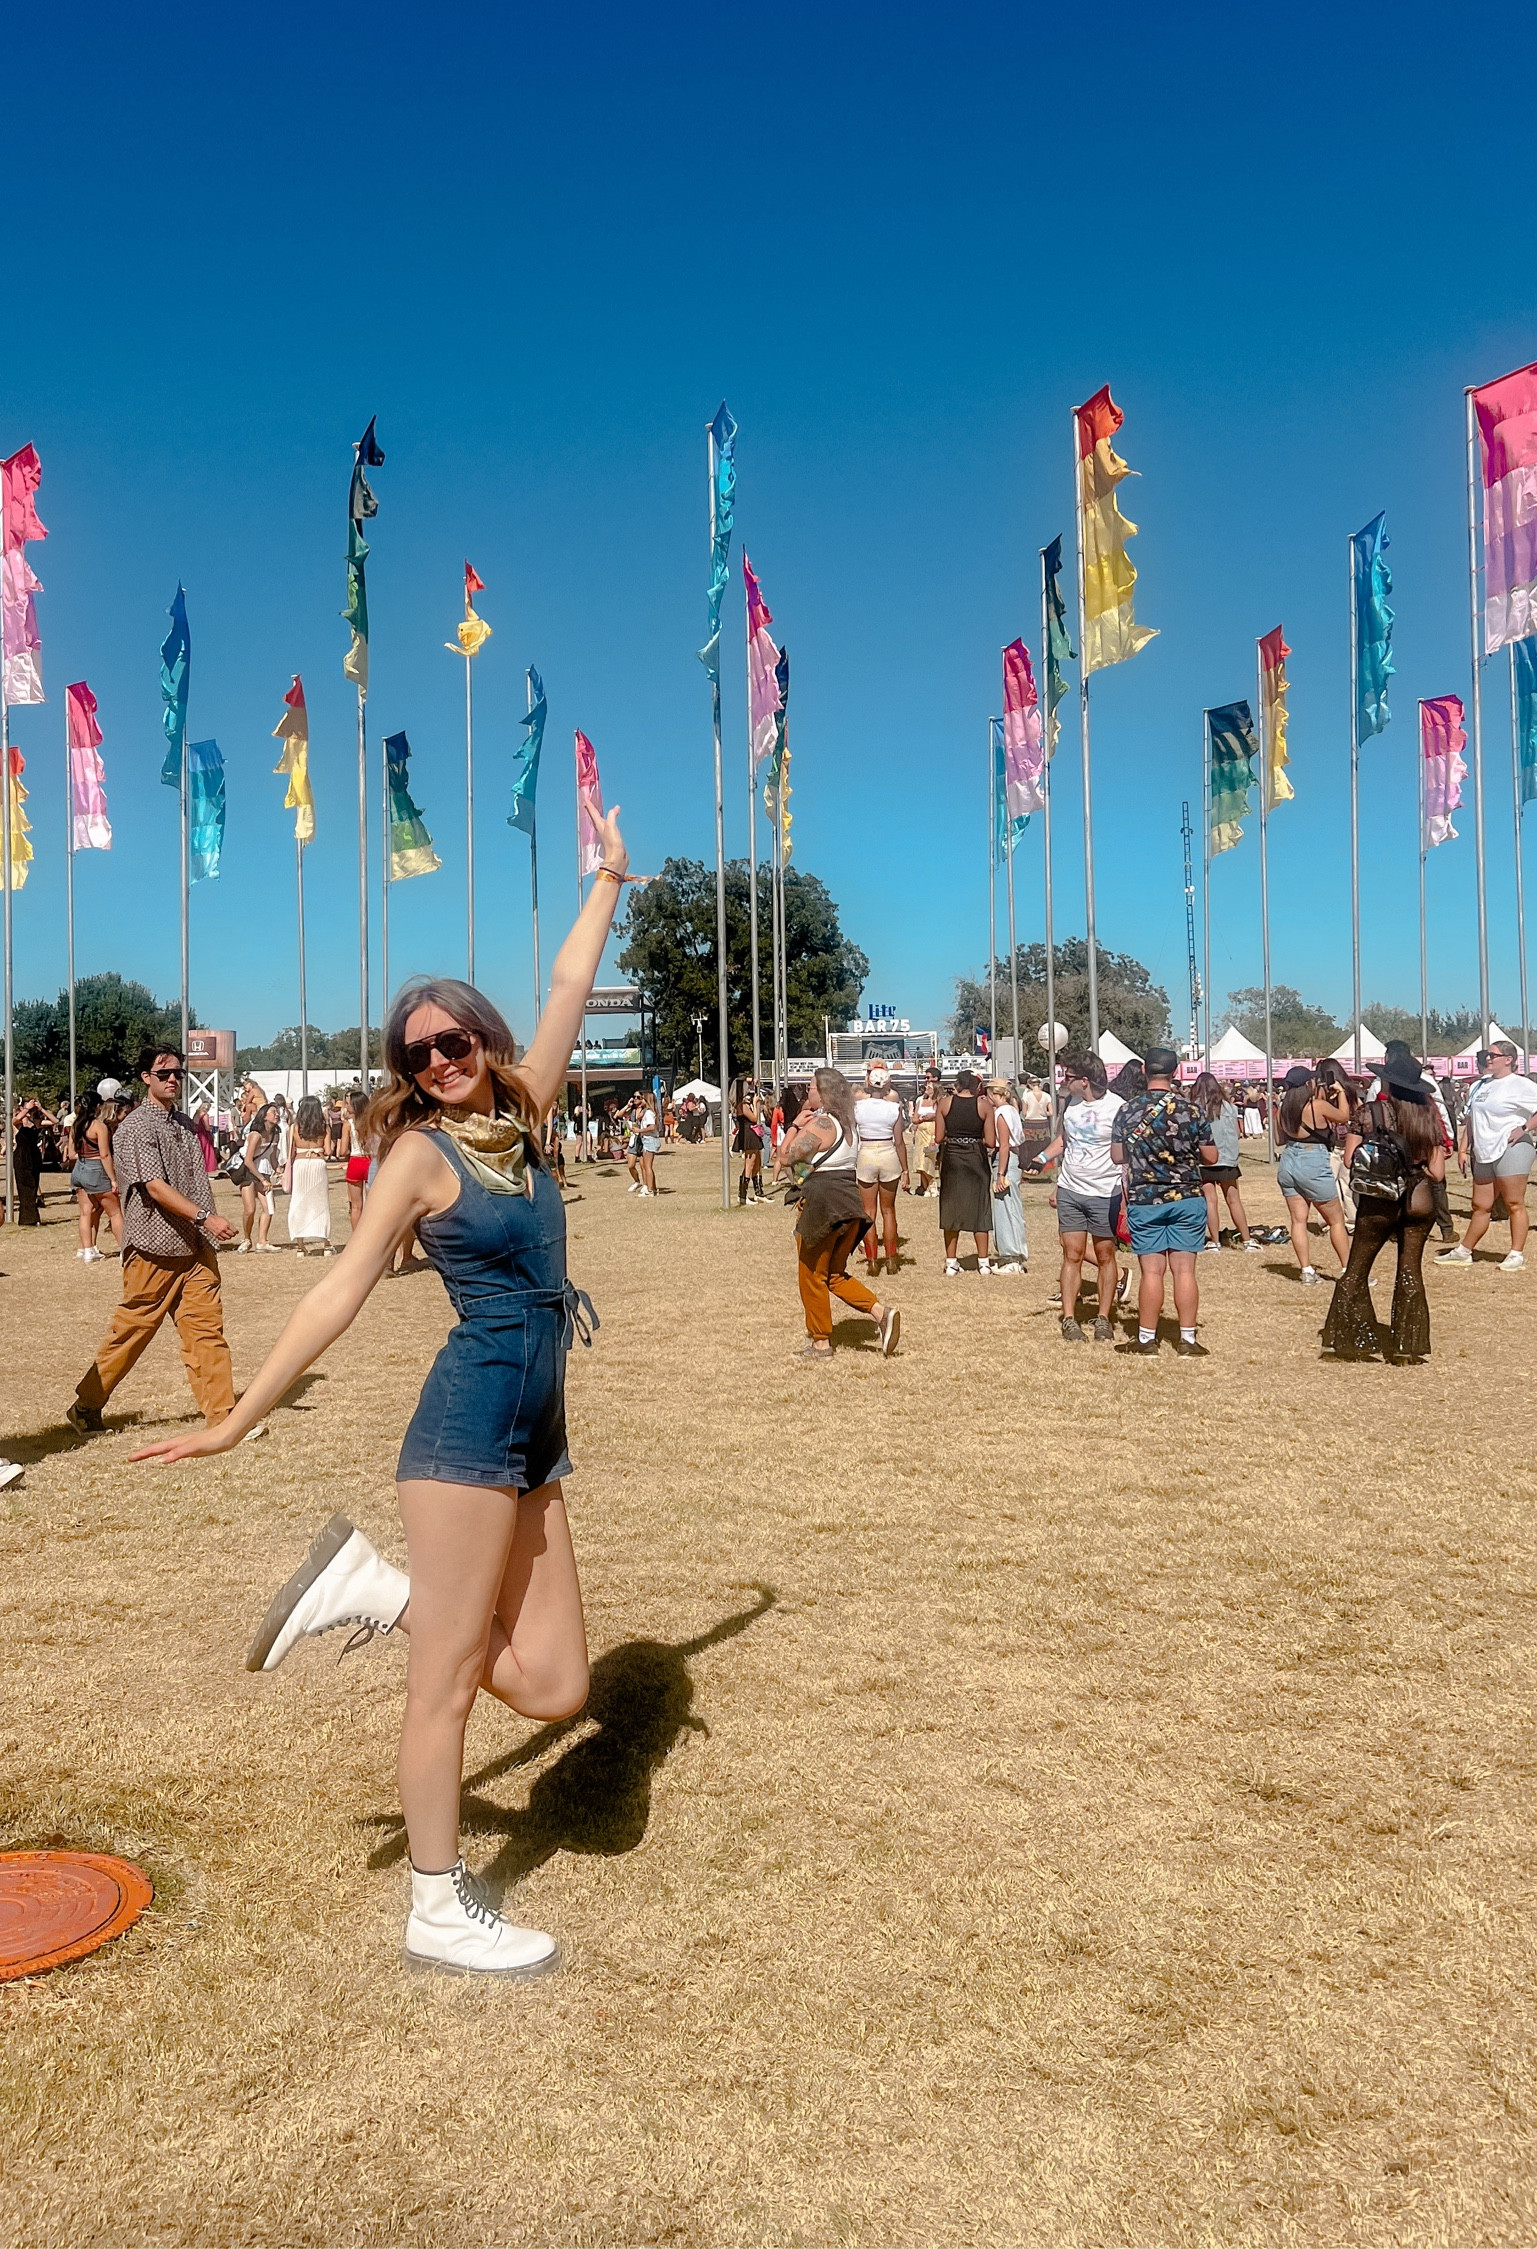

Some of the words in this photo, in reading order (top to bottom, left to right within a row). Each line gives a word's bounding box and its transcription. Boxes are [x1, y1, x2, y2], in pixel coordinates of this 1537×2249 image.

[586, 999, 633, 1007] ONDA
[869, 1004, 896, 1020] Lite
[854, 1019, 886, 1032] BAR
[890, 1018, 910, 1032] 75
[1457, 1061, 1469, 1069] BAR
[1187, 1066, 1198, 1074] BAR
